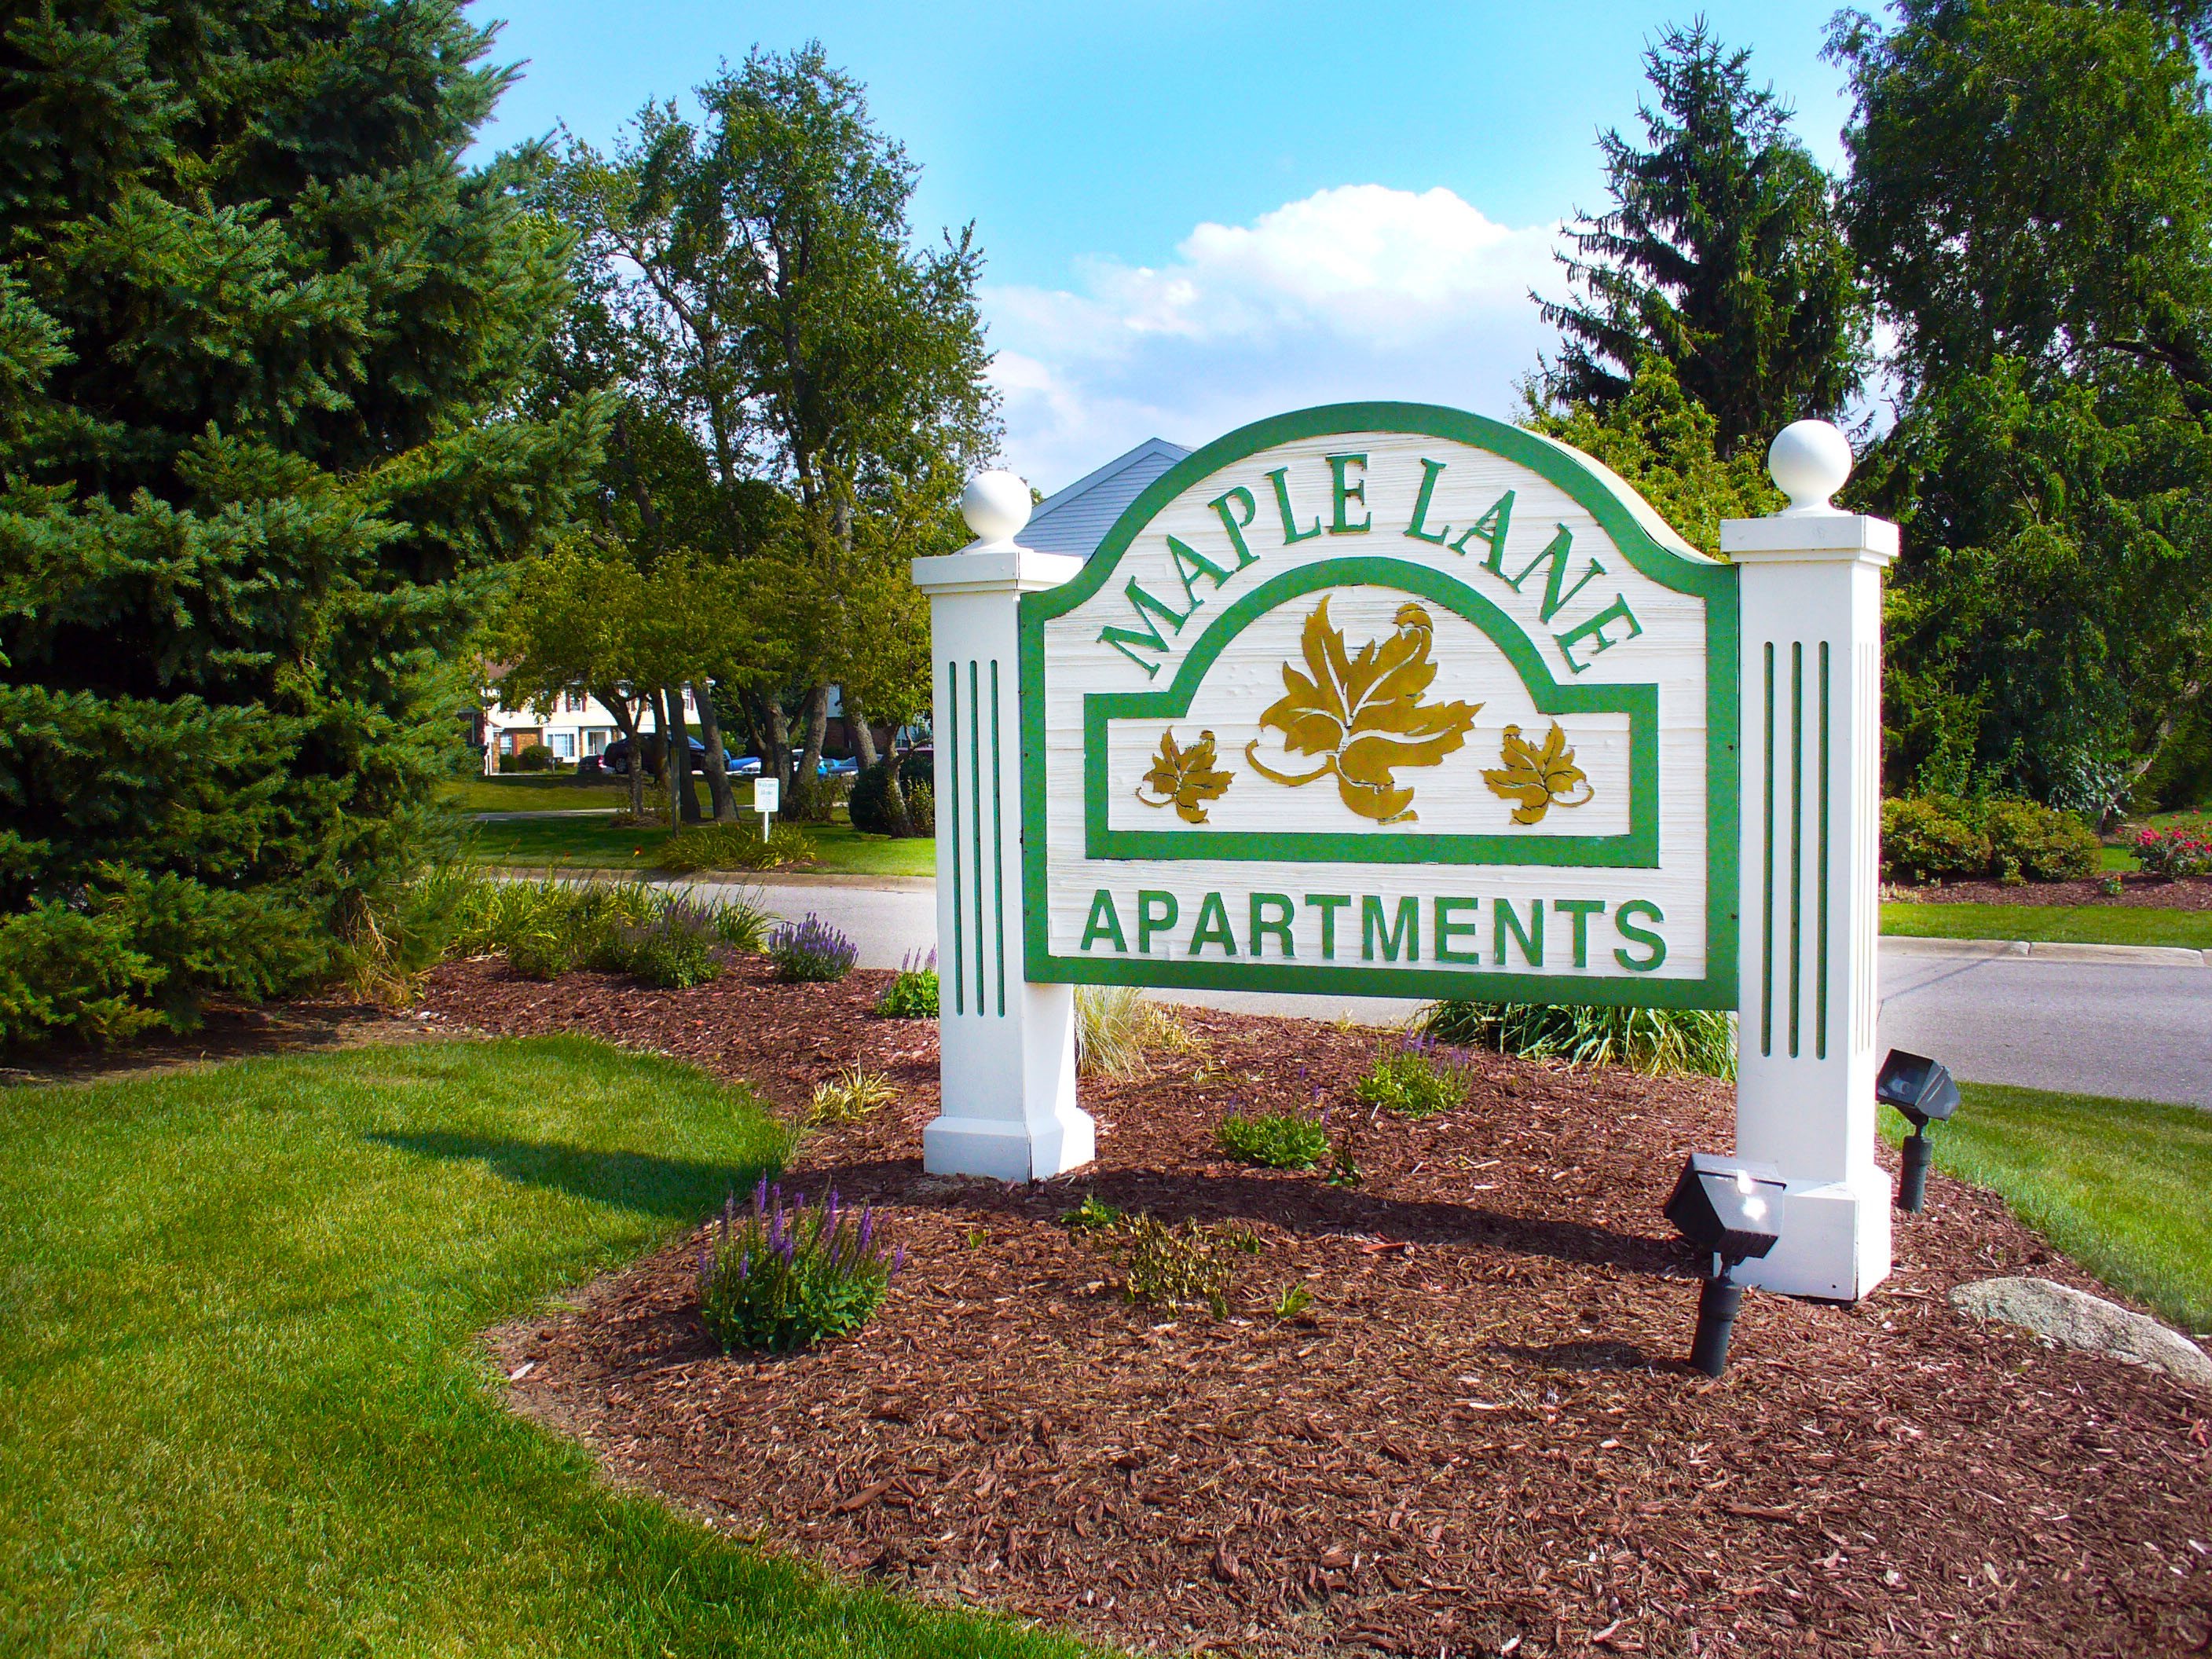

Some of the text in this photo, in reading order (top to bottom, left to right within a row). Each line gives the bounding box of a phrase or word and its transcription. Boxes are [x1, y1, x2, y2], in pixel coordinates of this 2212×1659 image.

[1097, 453, 1643, 679] MAPLE LANE
[1080, 888, 1668, 972] APARTMENTS
